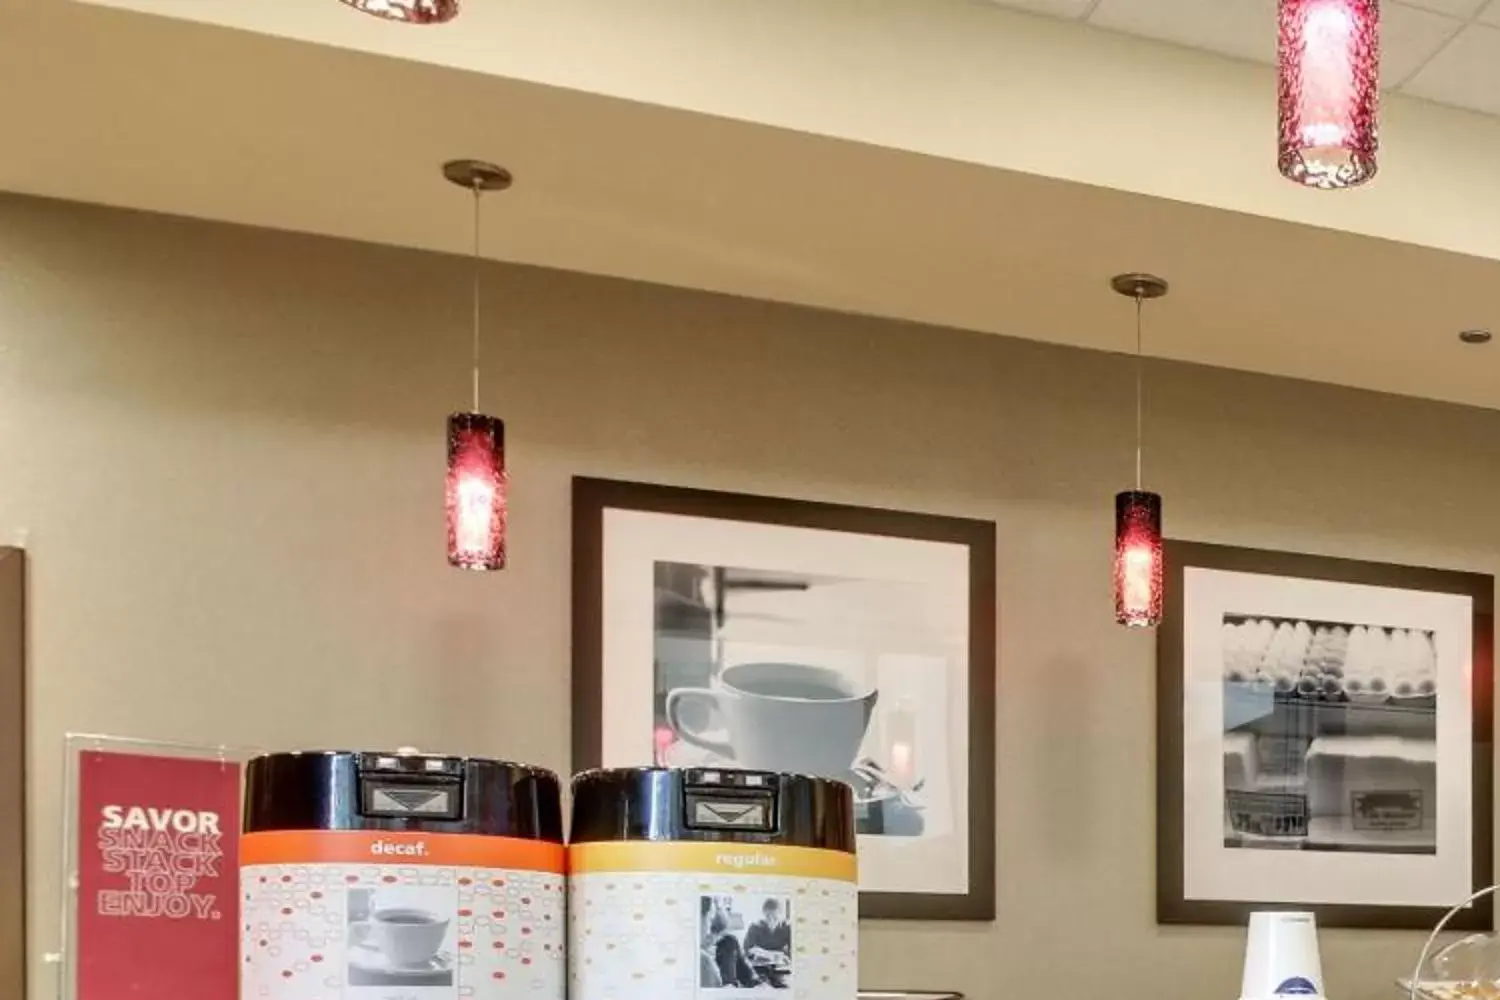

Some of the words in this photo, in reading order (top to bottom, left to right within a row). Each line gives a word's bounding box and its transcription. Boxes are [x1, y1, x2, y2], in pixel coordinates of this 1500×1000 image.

[102, 804, 220, 834] SAVOR
[102, 847, 223, 877] STACK
[370, 840, 429, 857] decaf.
[125, 870, 197, 896] TOP
[98, 889, 222, 919] ENJOY.
